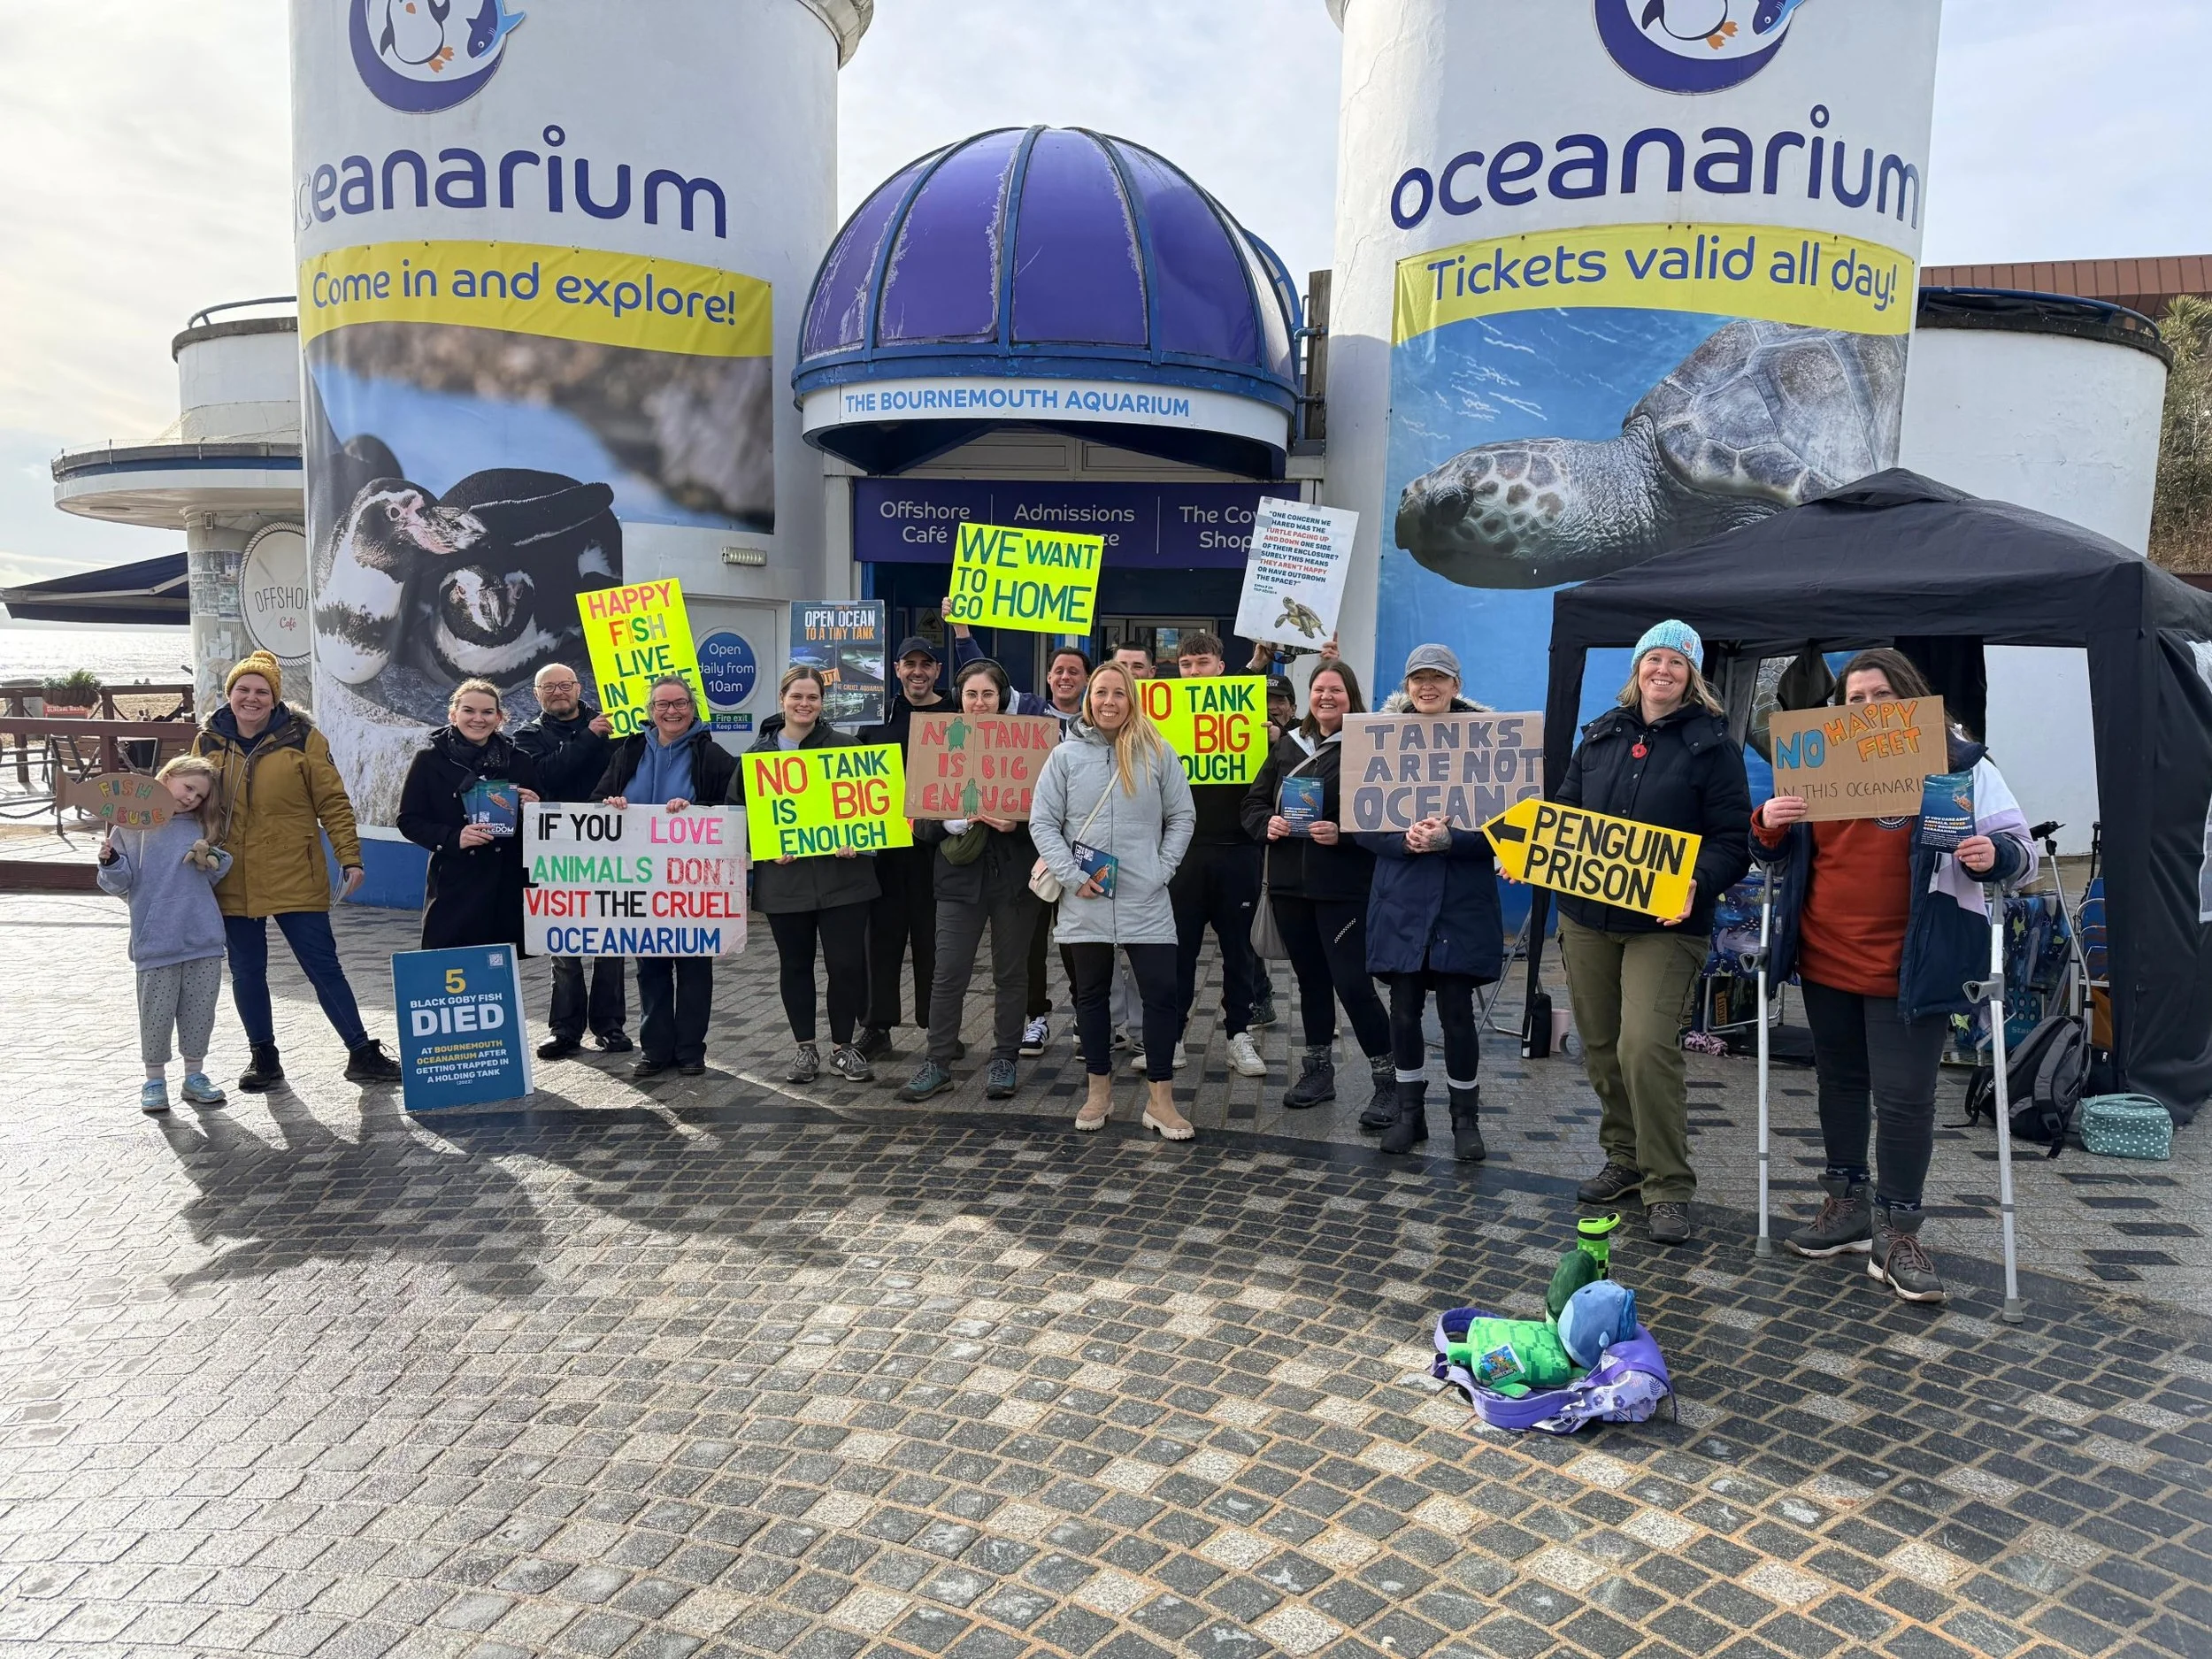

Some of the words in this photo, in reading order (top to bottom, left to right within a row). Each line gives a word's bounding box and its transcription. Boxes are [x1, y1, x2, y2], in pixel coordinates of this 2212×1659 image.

[1390, 104, 1920, 230] oceanarium
[293, 125, 726, 239] ceanarium
[1428, 245, 1606, 301] Tickets
[1624, 234, 1755, 281] valid
[1770, 241, 1819, 287] all
[1832, 249, 1897, 311] day!
[312, 270, 390, 308] Come
[403, 258, 437, 297] in
[452, 262, 540, 301] and
[556, 274, 735, 325] explore!
[846, 393, 876, 412] THE
[881, 389, 1058, 411] BOURNEMOUTH
[1064, 390, 1189, 418] AQUARIUM
[880, 501, 971, 521] Offshore
[1014, 503, 1135, 523] Admissions
[1179, 506, 1217, 523] The
[1286, 514, 1320, 526] CONCERN
[902, 525, 948, 544] Café
[1266, 527, 1292, 536] TURTLE
[1293, 531, 1318, 541] PACING
[1271, 519, 1294, 529] HARED
[1296, 523, 1310, 532] WAS
[1312, 526, 1325, 534] THE
[961, 526, 1023, 568] WE
[1026, 540, 1098, 569] WANT
[1199, 531, 1251, 552] Shop
[1264, 534, 1279, 543] AND
[1279, 537, 1300, 546] DOWN
[1315, 542, 1331, 551] SIDE
[1272, 544, 1293, 553] THEIR
[1294, 548, 1338, 561] ENCLOSURE?
[1260, 558, 1278, 567] THEY
[1302, 565, 1327, 575] HAPPY
[1261, 550, 1286, 560] SURELY
[1305, 557, 1328, 567] MEANS
[957, 566, 987, 593] TO
[1287, 571, 1326, 583] OUTGROWN
[588, 582, 670, 619] HAPPY
[951, 594, 983, 619] GO
[992, 580, 1092, 623] HOME
[279, 616, 296, 631] Café
[609, 613, 667, 646] FISH
[805, 611, 834, 627] OPEN
[838, 610, 875, 627] OCEAN
[805, 627, 817, 641] TO
[818, 627, 826, 641] A
[828, 626, 848, 640] TINY
[852, 626, 875, 640] TANK
[615, 644, 674, 678] LIVE
[709, 643, 741, 658] Open
[726, 663, 754, 674] from
[603, 681, 629, 708] IN
[709, 681, 743, 692] 10am
[1185, 684, 1256, 712] TANK
[717, 713, 732, 722] Fire
[976, 721, 1050, 749] TANK
[1194, 713, 1250, 754] BIG
[1364, 718, 1525, 751] TANKS
[1776, 729, 1824, 769] NO
[1824, 700, 1918, 747] HAPPY
[1856, 726, 1922, 763] FEET
[756, 757, 808, 796] NO
[818, 749, 890, 780] TANK
[938, 753, 966, 778] IS
[981, 755, 1028, 780] BIG
[1179, 754, 1246, 781] OUGH
[1363, 752, 1451, 784] ARE
[1462, 748, 1543, 785] NOT
[98, 780, 154, 800] FISH
[772, 798, 797, 825] IS
[831, 778, 890, 820] BIG
[1778, 785, 1795, 797] IN
[1802, 782, 1838, 799] THIS
[101, 803, 165, 825] ABUSE
[539, 813, 562, 841] IF
[570, 814, 623, 841] YOU
[650, 817, 723, 844] LOVE
[780, 821, 887, 856] ENOUGH
[1532, 805, 1687, 876] PENGUIN
[532, 855, 653, 883] ANIMALS
[1524, 843, 1656, 910] PRISON
[525, 889, 591, 918] VISIT
[595, 890, 647, 918] THE
[652, 891, 741, 918] CRUEL
[547, 926, 720, 954] OCEANARIUM
[445, 969, 466, 994] 5
[410, 997, 446, 1009] BLACK
[448, 995, 477, 1004] GOBY
[479, 993, 502, 1002] FISH
[411, 1003, 504, 1037] DIED
[417, 1052, 477, 1065] OCEANARIUM
[478, 1048, 506, 1059] AFTER
[434, 1040, 503, 1055] BOURNEMOUTH
[416, 1064, 456, 1075] GETTING
[457, 1059, 498, 1071] TRAPPED
[434, 1071, 475, 1083] HOLDING
[476, 1068, 500, 1078] TANK
